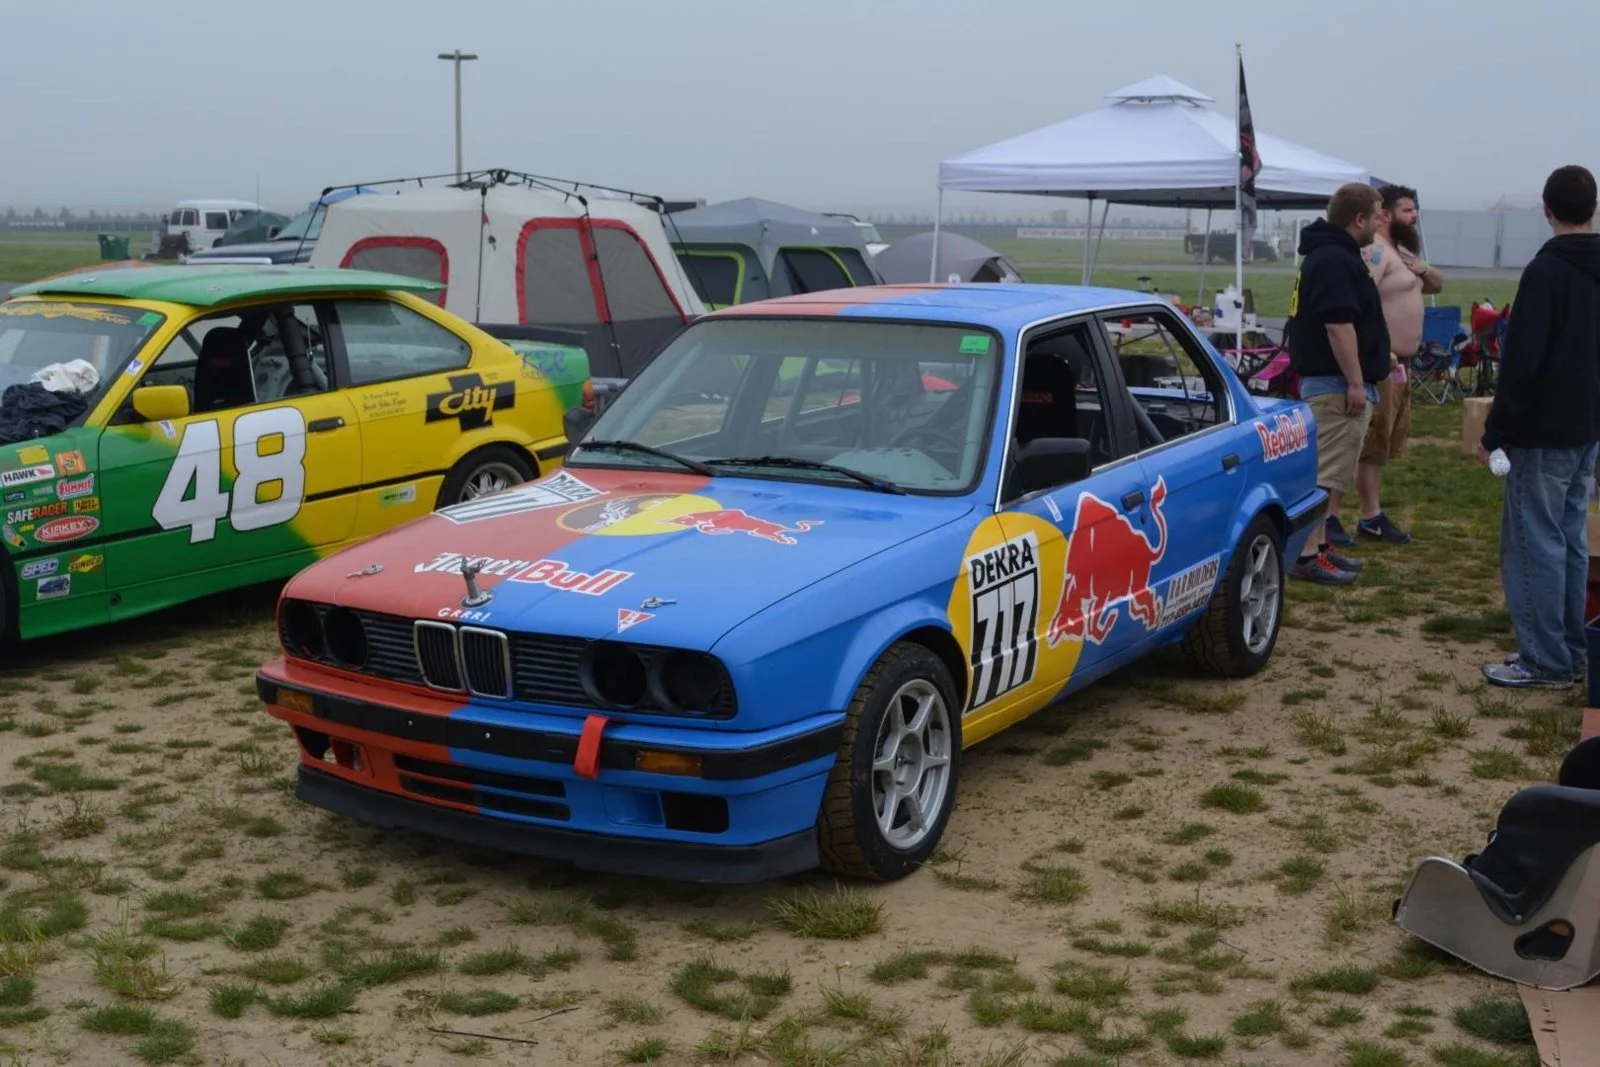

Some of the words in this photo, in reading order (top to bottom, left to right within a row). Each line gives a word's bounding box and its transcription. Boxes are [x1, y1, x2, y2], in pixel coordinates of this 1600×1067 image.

[3, 468, 37, 483] HAWK
[152, 406, 306, 544] 48
[23, 562, 58, 577] SPEC
[971, 538, 1035, 590] DEKRA
[437, 606, 492, 623] GRRR!
